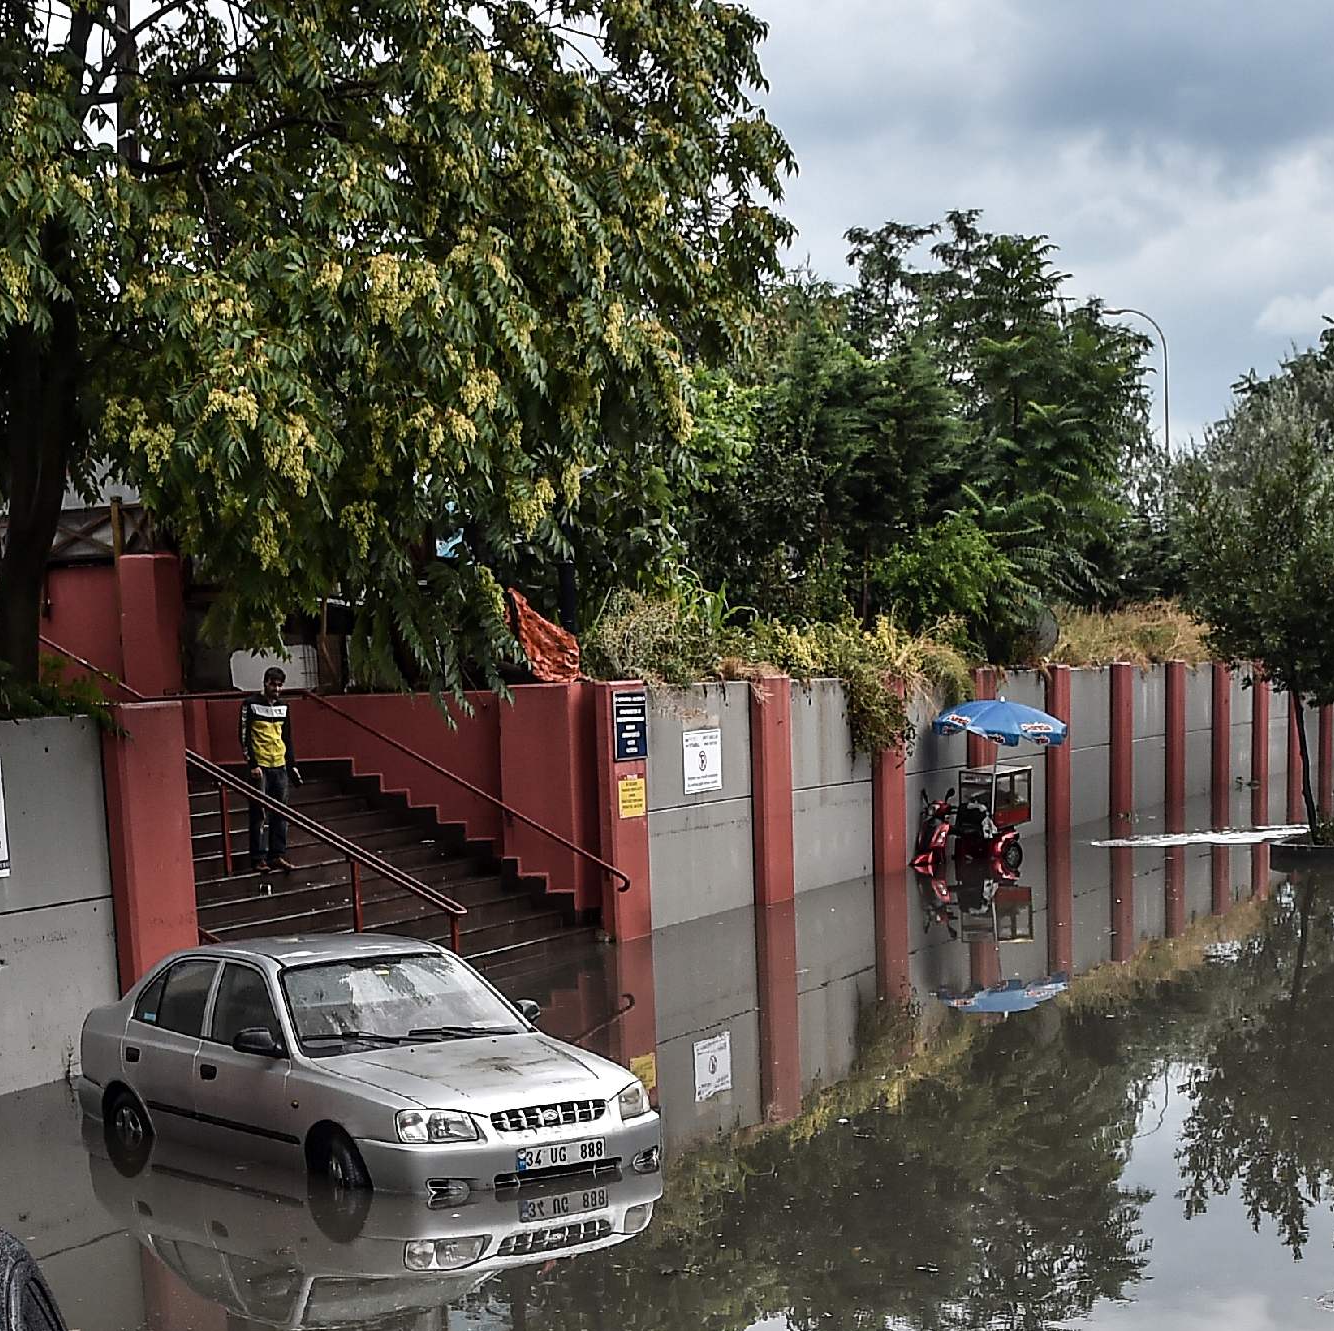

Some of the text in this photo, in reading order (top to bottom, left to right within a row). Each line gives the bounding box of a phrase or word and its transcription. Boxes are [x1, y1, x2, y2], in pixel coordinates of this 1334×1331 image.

[526, 1149, 542, 1167] 34
[550, 1146, 567, 1164] UG
[580, 1140, 603, 1159] 888
